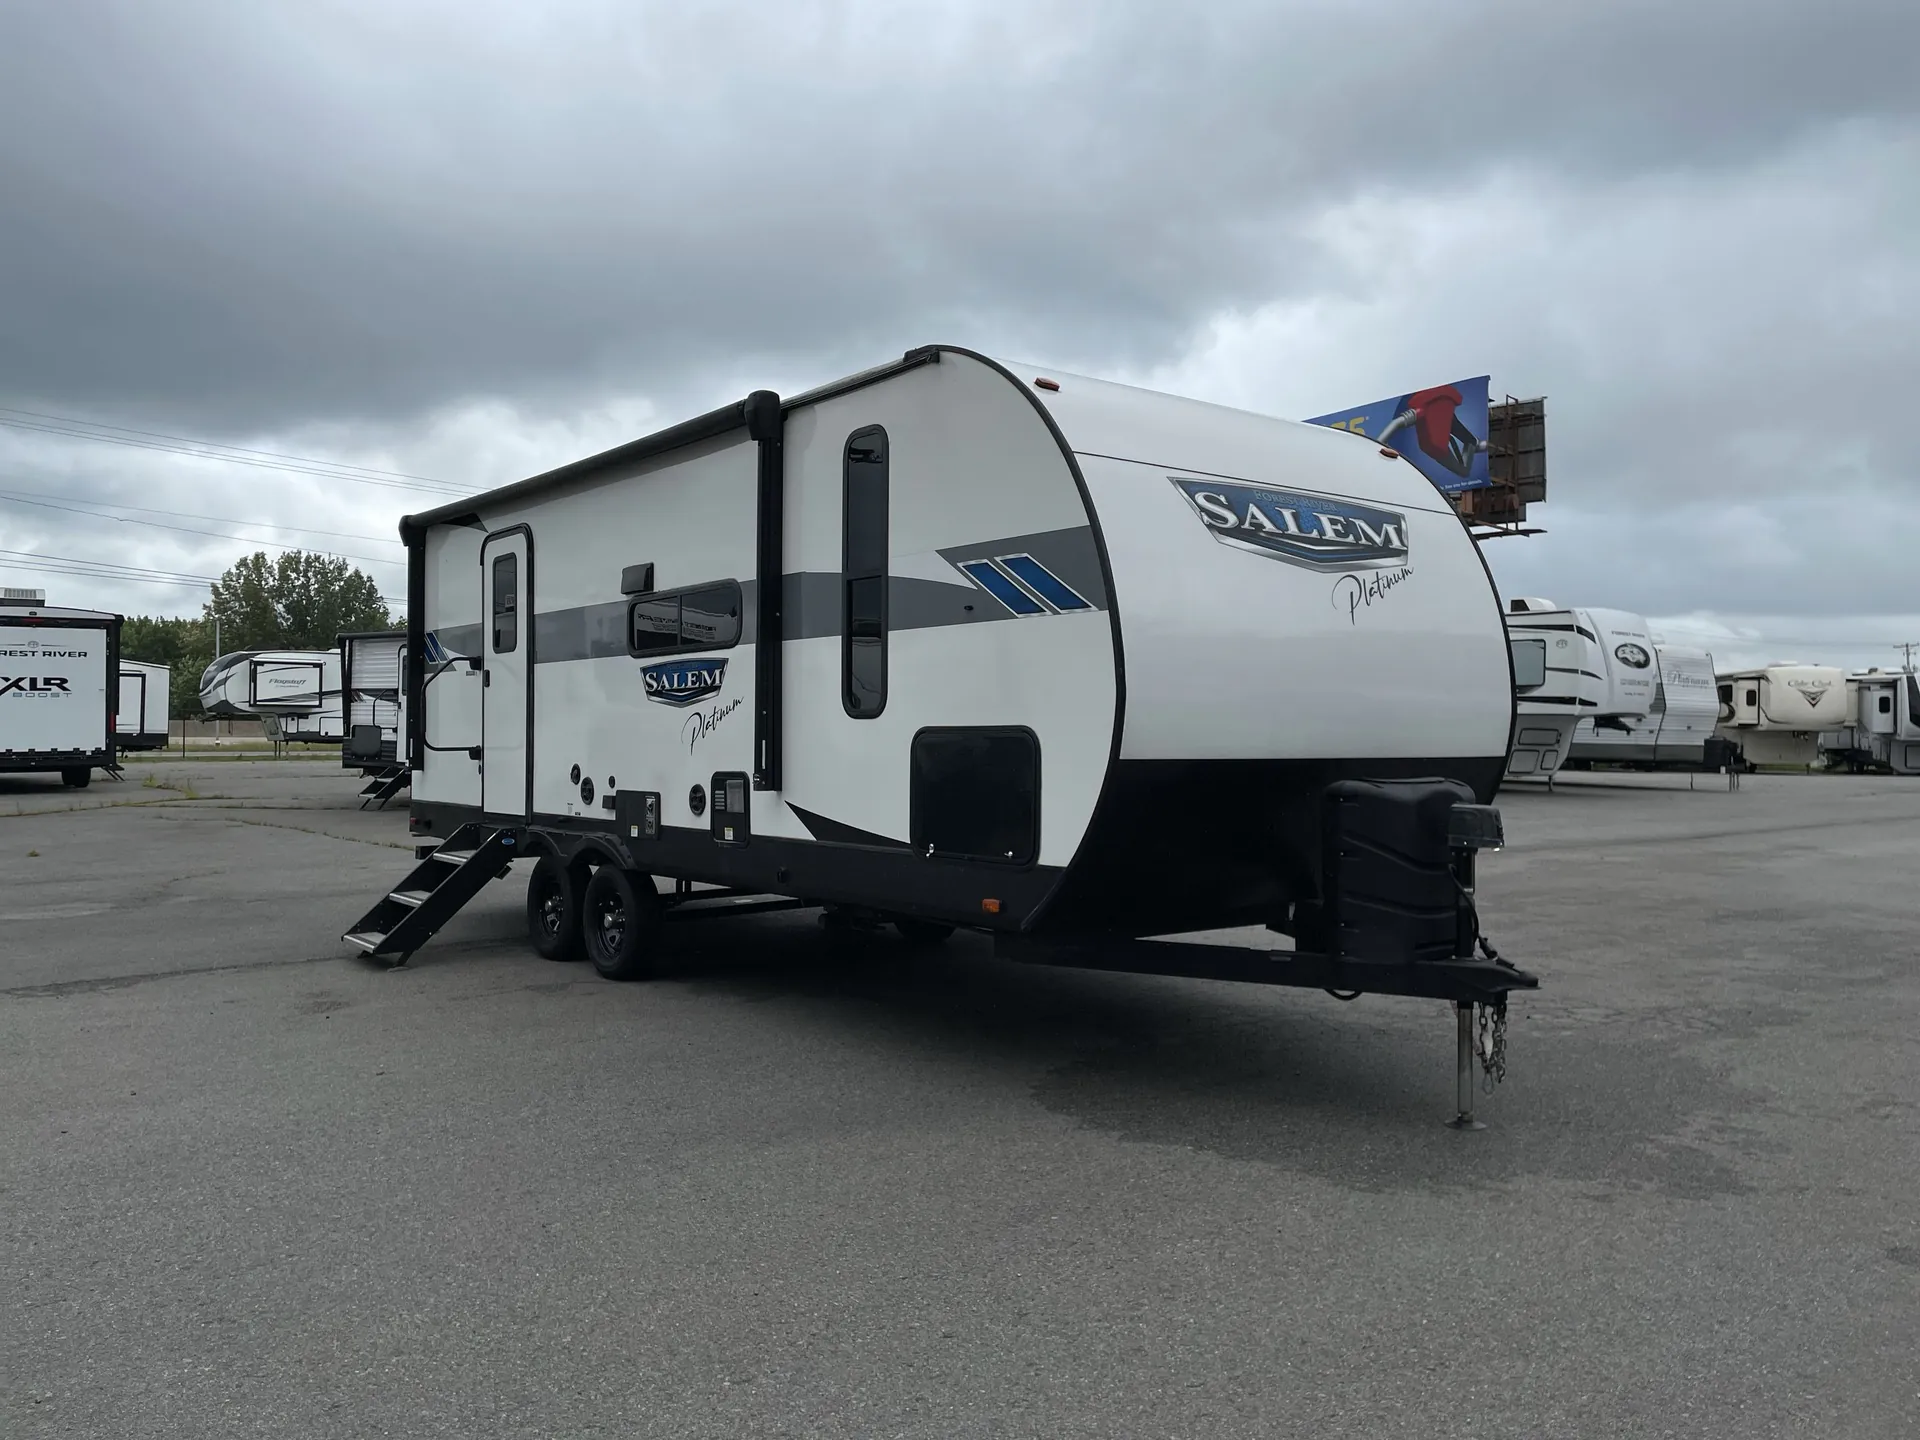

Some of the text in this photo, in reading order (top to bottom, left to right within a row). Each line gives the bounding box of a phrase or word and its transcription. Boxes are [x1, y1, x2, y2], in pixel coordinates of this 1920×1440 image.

[1195, 491, 1408, 551] SALEM
[1332, 566, 1414, 626] Platinum
[42, 650, 88, 658] RIVER
[0, 676, 72, 696] XLR
[645, 668, 723, 692] SALEM
[680, 696, 745, 757] Platinum
